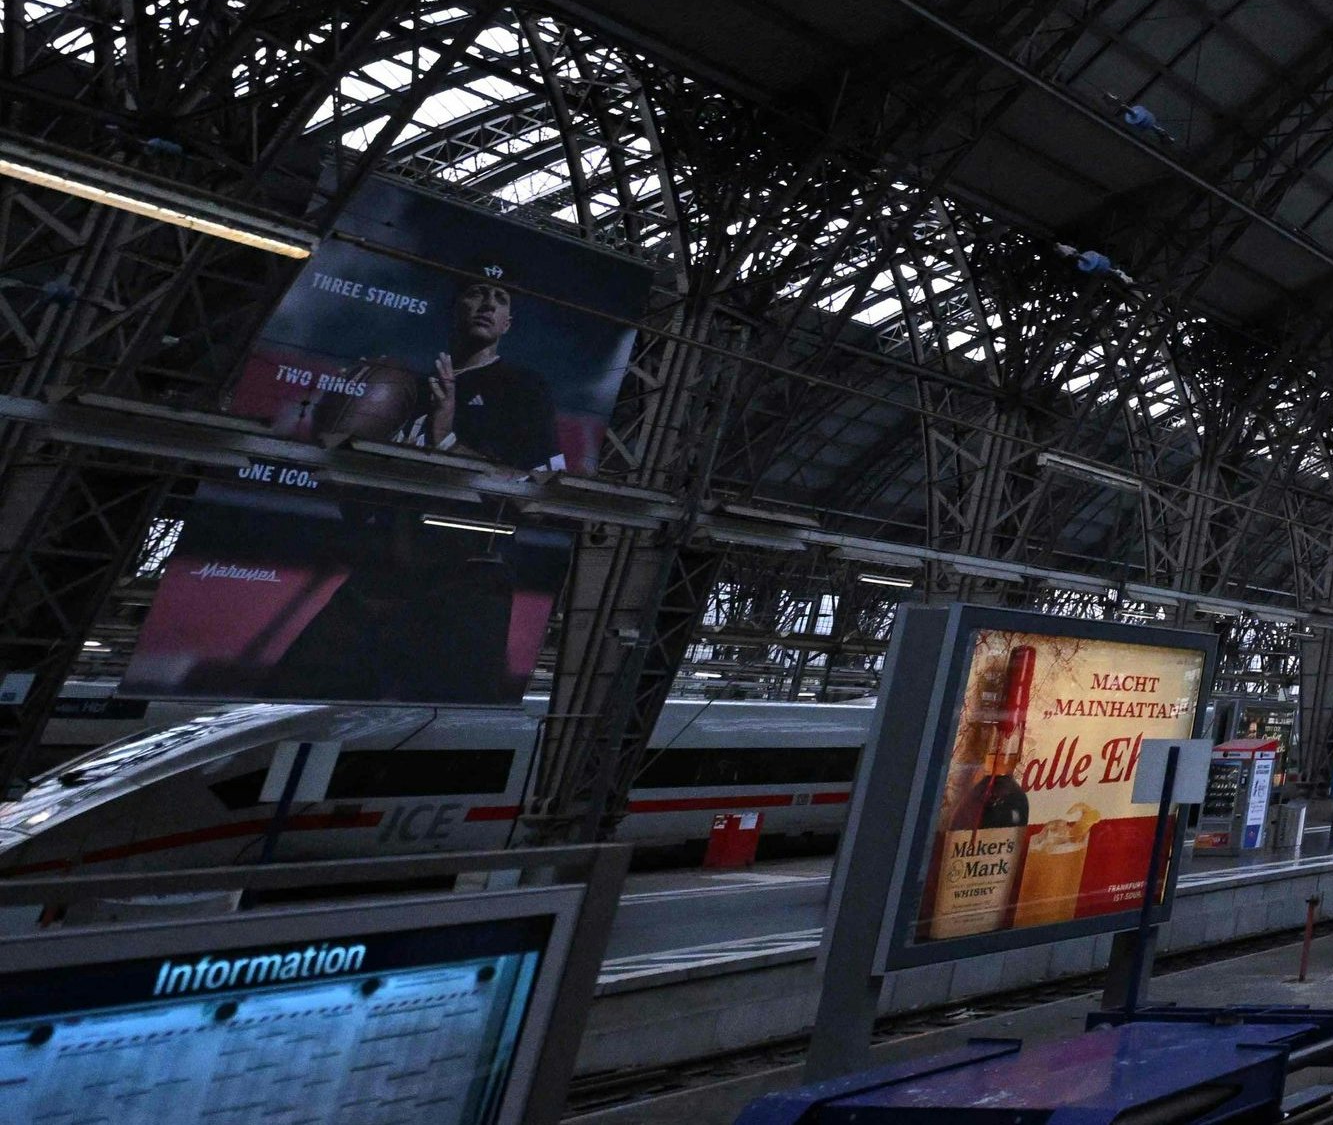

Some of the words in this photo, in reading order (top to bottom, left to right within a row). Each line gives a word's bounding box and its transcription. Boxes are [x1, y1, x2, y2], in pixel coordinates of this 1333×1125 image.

[311, 273, 363, 299] THREE
[365, 287, 428, 315] STRIPES
[276, 365, 313, 386] TWO
[317, 374, 367, 397] RINGS
[1091, 673, 1160, 693] MACHT
[1022, 735, 1093, 792] alle
[379, 803, 463, 842] ICE
[950, 838, 1016, 859] Maker's
[962, 858, 1009, 879] Mark
[152, 941, 367, 996] Information
